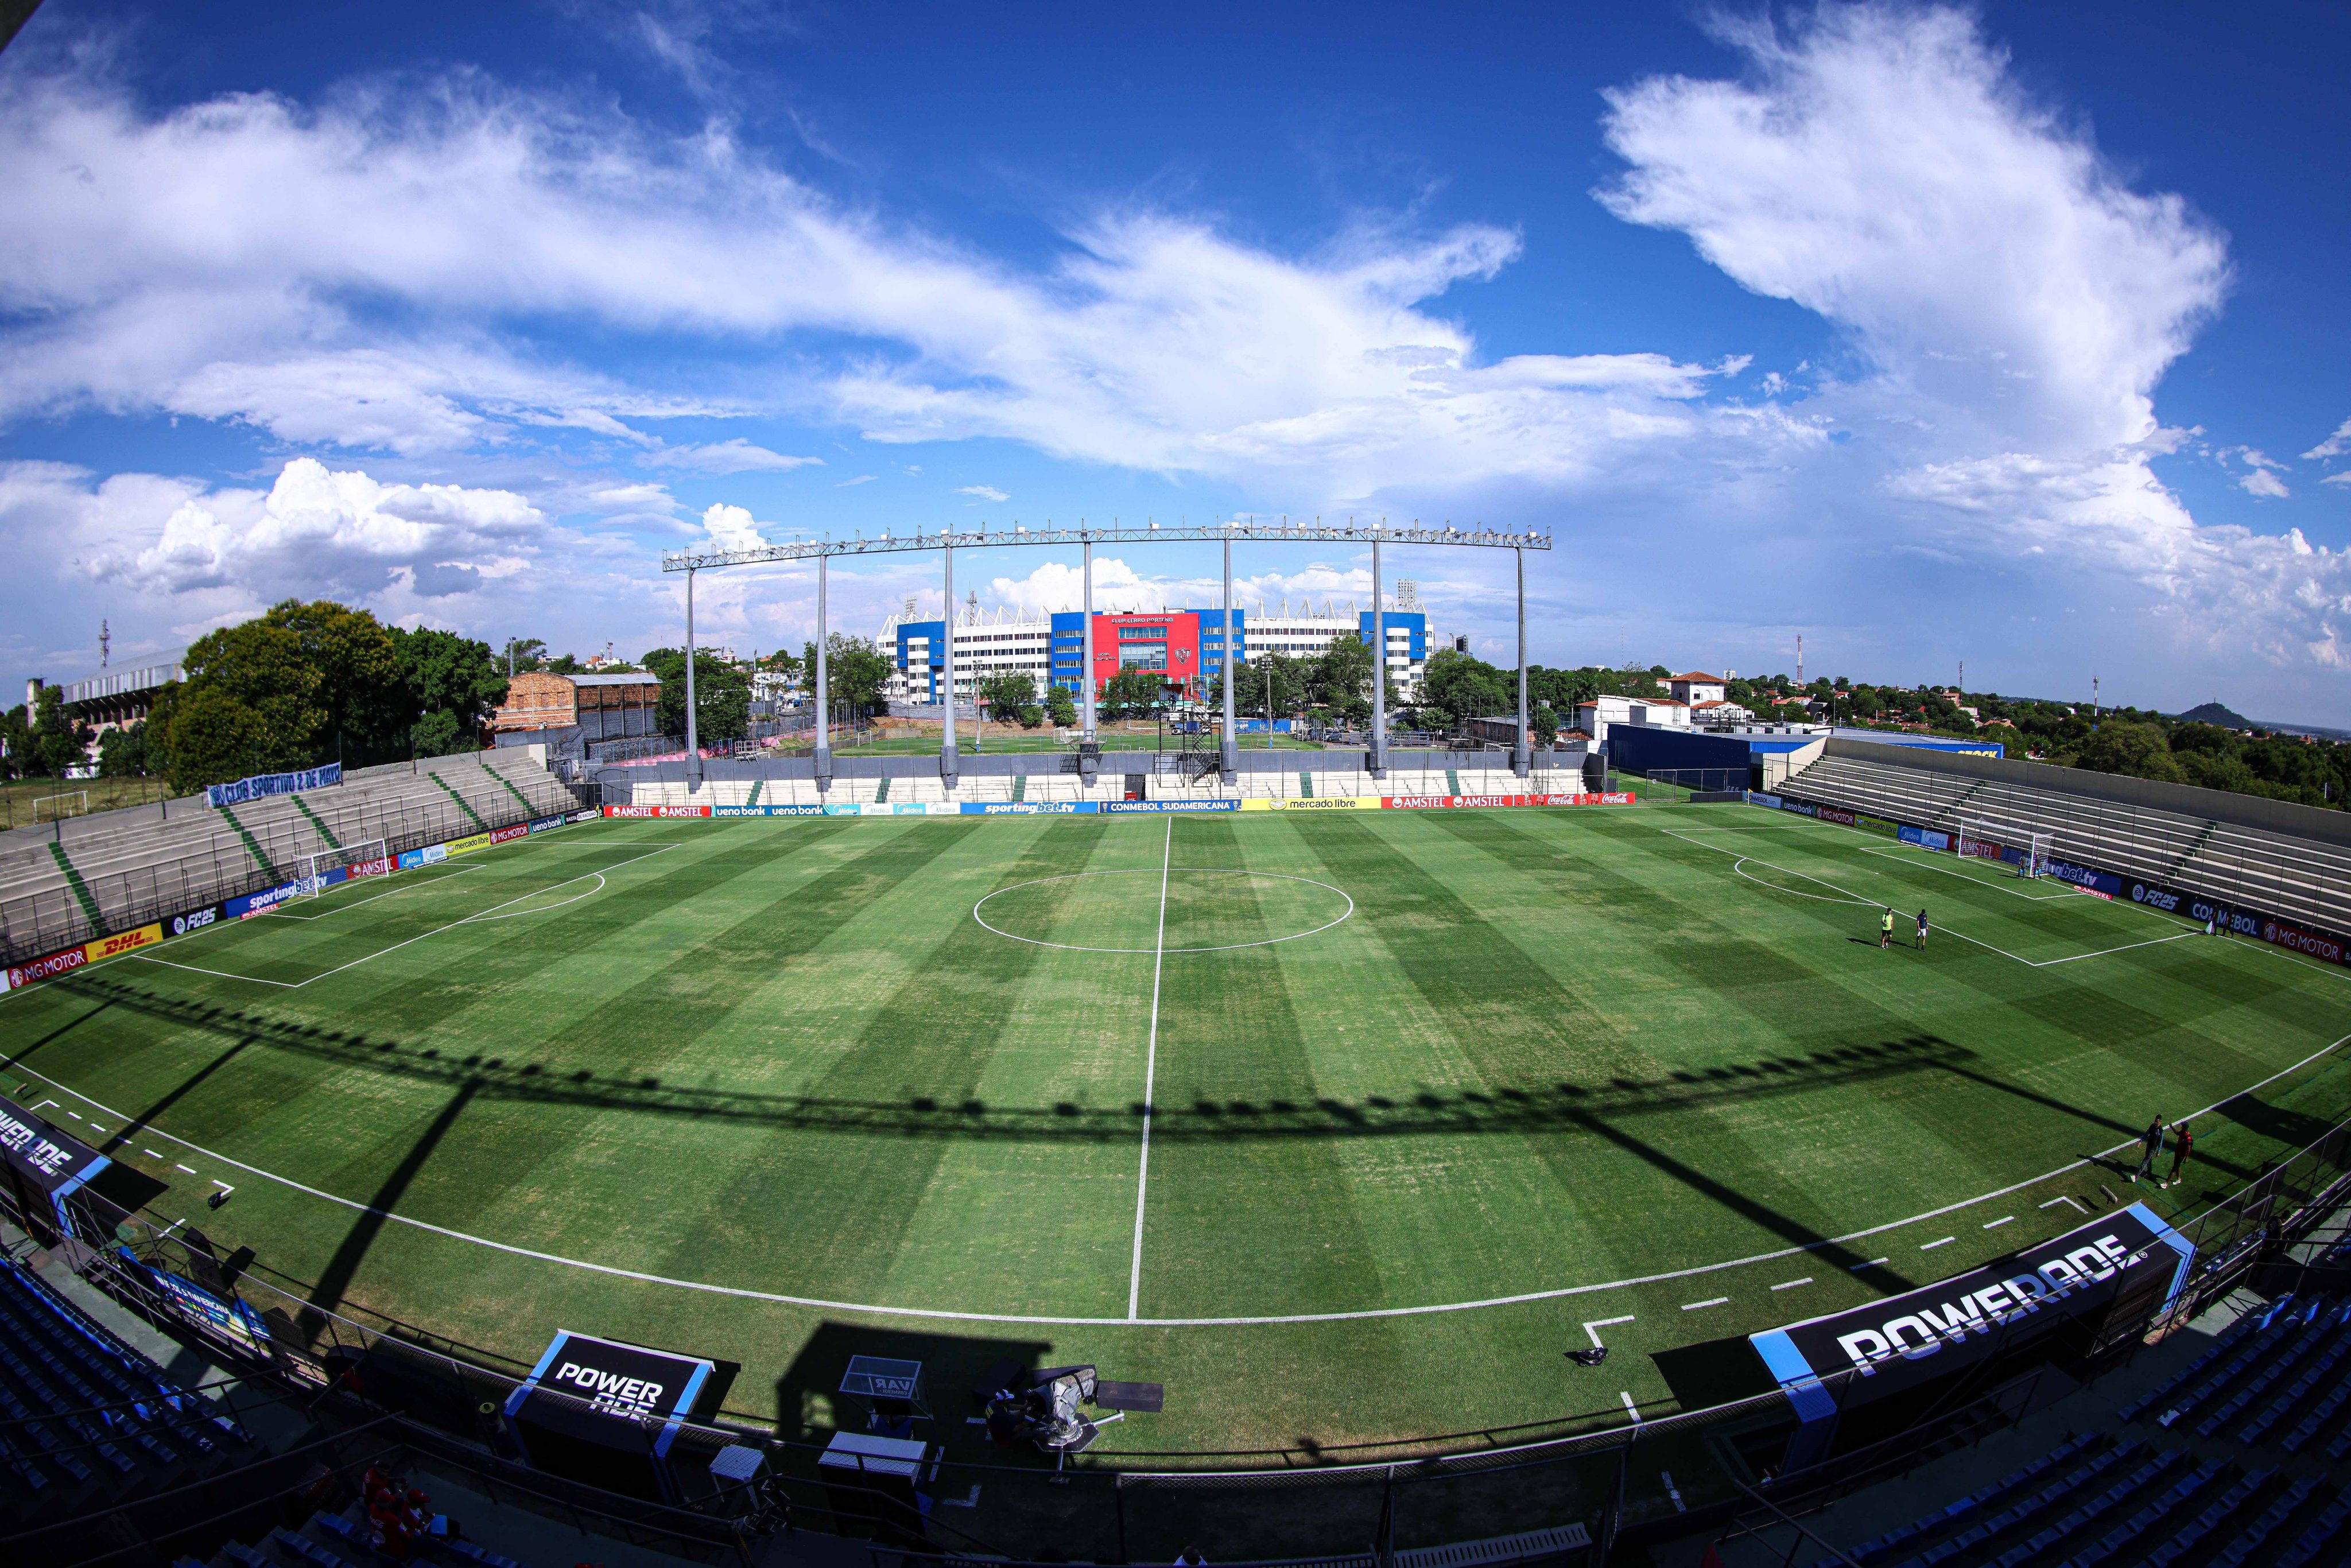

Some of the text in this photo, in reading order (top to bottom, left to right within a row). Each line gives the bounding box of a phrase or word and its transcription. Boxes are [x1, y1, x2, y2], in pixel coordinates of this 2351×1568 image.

[226, 764, 340, 804] CLUB SPORTIVO 2 DE MAYO
[1290, 799, 1356, 808] mercado libre
[1403, 797, 1445, 808] AMSTEL
[1464, 796, 1504, 807] AMSTEL
[1547, 794, 1575, 805] Coca-Cola
[1601, 793, 1628, 804] Coca-Cola
[620, 806, 653, 817] AMSTEL
[668, 806, 703, 817] AMSTEL
[717, 806, 765, 816] ueno bank
[772, 805, 823, 815] ueno bank
[836, 805, 858, 814] Midea
[867, 805, 889, 814] Midea
[899, 805, 922, 814] Midea
[933, 805, 956, 813] Midea
[985, 801, 1075, 814] sportingbet.tv
[1111, 801, 1230, 812] CONMEBOL SUDAMERICANA
[1784, 802, 1812, 815] ueno bank
[1823, 810, 1832, 819] MG
[1834, 812, 1853, 824] MOTOR
[533, 817, 561, 832] ueno bank
[1863, 820, 1896, 834] mercado libre
[498, 830, 507, 841] MG
[508, 826, 528, 838] MOTOR
[1903, 829, 1919, 840] Midea
[1927, 834, 1944, 846] Midea
[455, 837, 489, 851] mercado libre
[404, 854, 421, 865] Midea
[428, 849, 444, 859] Midea
[362, 858, 393, 875] AMSTL
[250, 875, 327, 909] sportingbettv
[2082, 888, 2111, 900] AMSTEL
[2143, 890, 2180, 910] FC25
[250, 903, 280, 917] AMSTEL
[186, 907, 216, 931] FC25
[2193, 903, 2257, 935] COMBOL
[103, 931, 145, 956] DHL
[2278, 929, 2296, 946] MG
[2298, 935, 2338, 960] MOTOR
[24, 963, 43, 981] MG
[44, 950, 86, 975] MOTOR
[0, 1109, 73, 1175] WERADE
[1837, 1234, 2142, 1377] POWERADE
[555, 1361, 663, 1404] POWER
[589, 1392, 655, 1422] ADE
